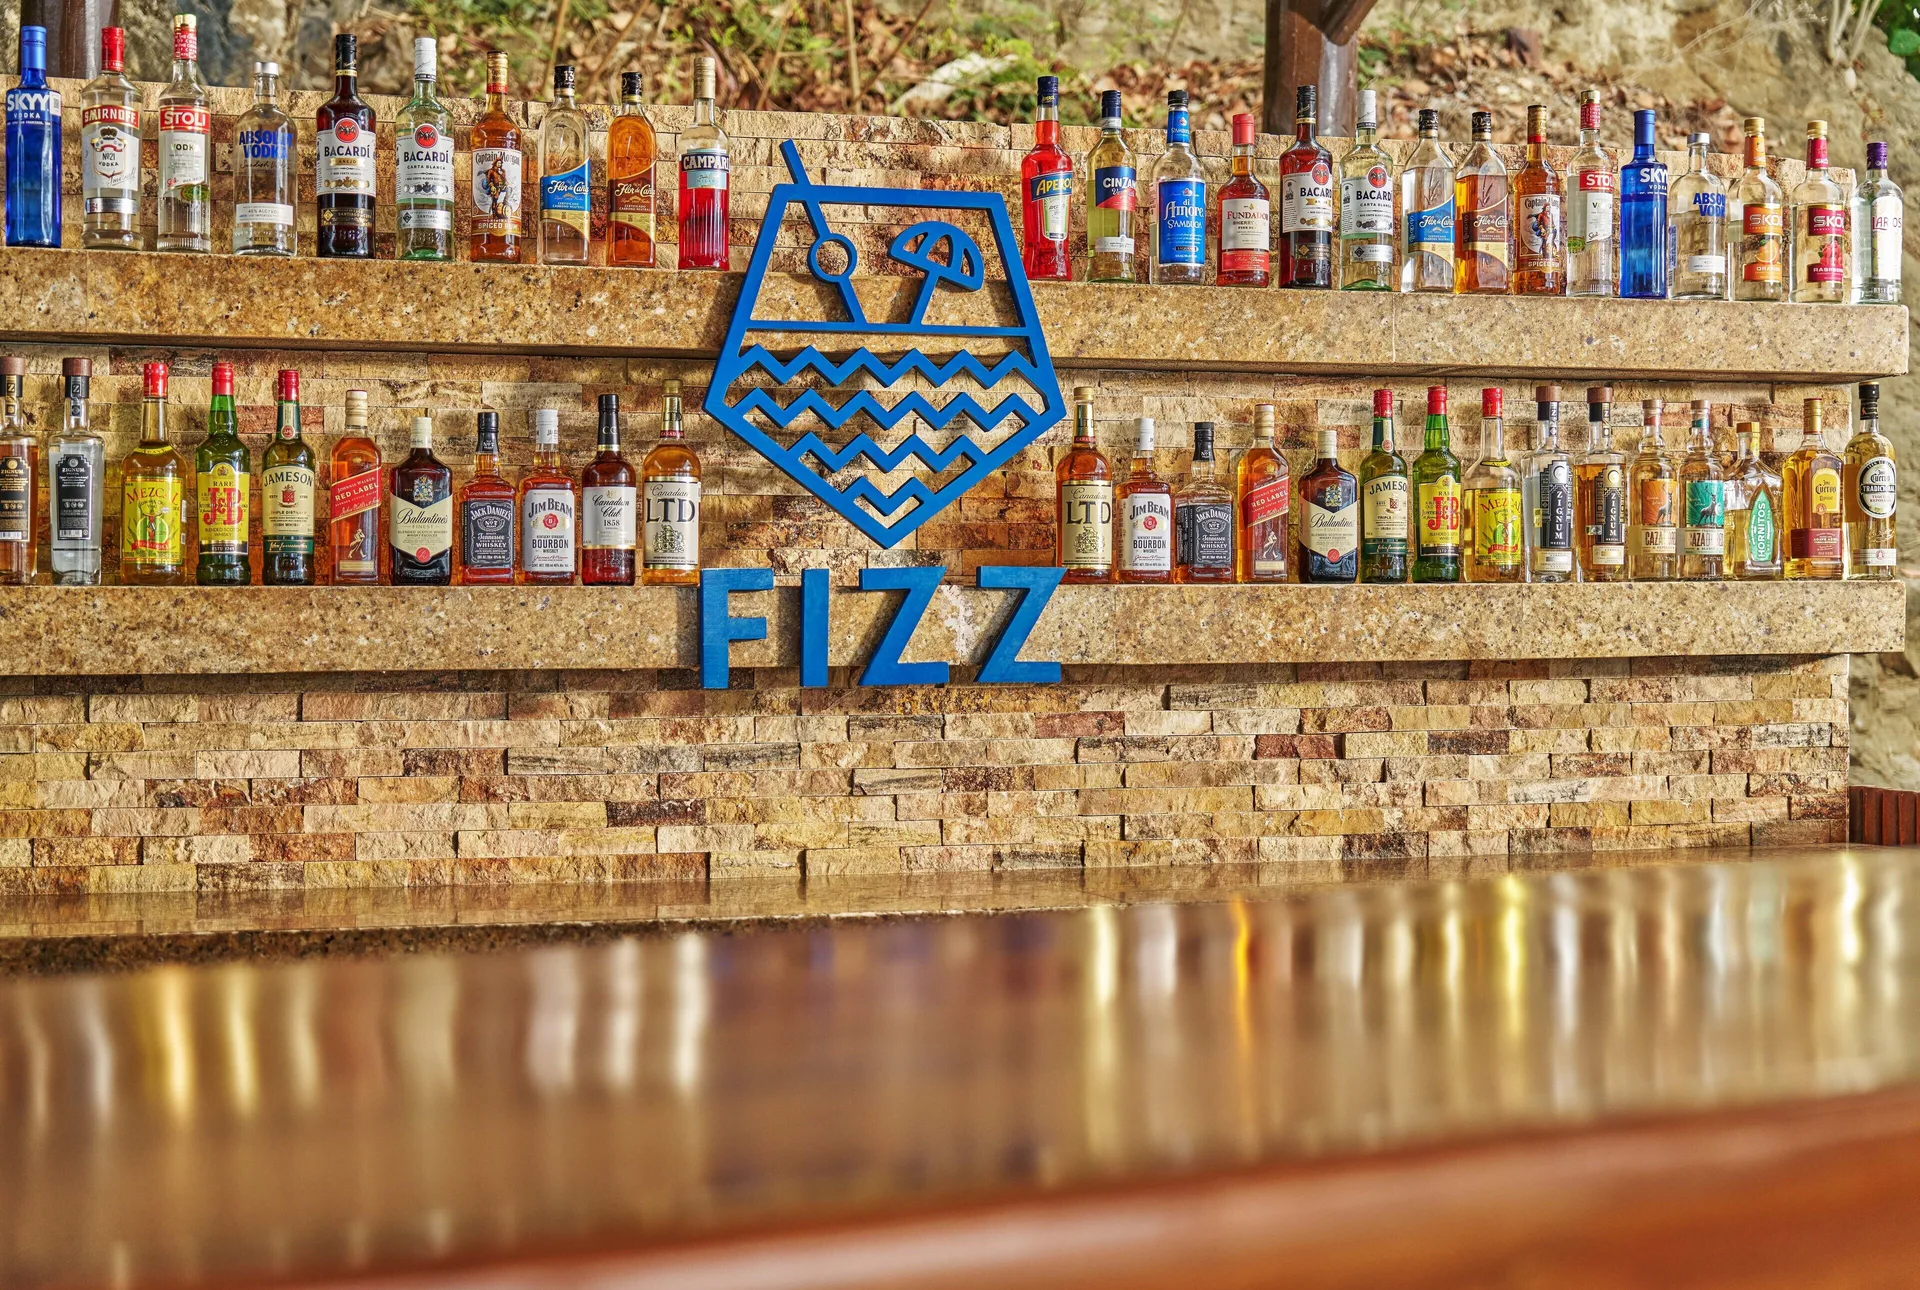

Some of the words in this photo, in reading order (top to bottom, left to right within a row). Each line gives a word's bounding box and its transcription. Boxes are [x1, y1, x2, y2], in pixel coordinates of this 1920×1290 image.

[7, 93, 49, 111] SKYY
[164, 110, 206, 126] STOLI
[324, 145, 370, 158] BACARDÍ
[404, 150, 449, 163] BACARDÍ
[475, 151, 497, 165] Captain
[683, 154, 729, 169] CAMPARI
[548, 180, 568, 194] Flor
[615, 183, 634, 196] Flor
[1165, 201, 1204, 220] Amore
[1524, 197, 1544, 209] Captain
[1420, 215, 1437, 227] Flor
[1474, 215, 1491, 227] Flor
[1872, 216, 1901, 231] LAROS
[8, 383, 15, 392] Z
[72, 384, 80, 393] Z
[662, 411, 682, 421] LTD
[264, 471, 313, 487] JAMESON
[337, 482, 357, 493] JOHNNIE
[356, 476, 376, 485] WALKER
[1870, 473, 1891, 483] Cuervo
[335, 491, 351, 501] RED
[353, 481, 379, 495] LABEL
[650, 484, 688, 497] Canadian
[1071, 488, 1108, 500] Canadian
[1815, 484, 1837, 494] Cuervo
[203, 487, 243, 525] J&B
[592, 494, 630, 507] Canadian
[1251, 499, 1266, 508] RED
[1267, 489, 1288, 502] LABEL
[470, 508, 487, 520] JACK
[487, 505, 512, 521] DANIEL'S
[528, 501, 546, 519] JIM
[547, 497, 573, 519] BEAM
[600, 505, 621, 519] Club
[646, 497, 696, 523] LTD
[1066, 500, 1112, 525] LTD
[1129, 504, 1147, 520] JIM
[1147, 501, 1169, 521] BEAM
[1427, 496, 1459, 531] J&B
[1554, 490, 1564, 540] ZIGNUM
[1609, 492, 1617, 537] ZIGNUM
[396, 508, 448, 525] Ballantine's
[1196, 511, 1210, 523] JACK
[1757, 502, 1766, 560] HORNITOS
[532, 539, 569, 549] BOURBON
[1133, 540, 1167, 549] BOURBON
[701, 566, 1065, 690] FIZZ
